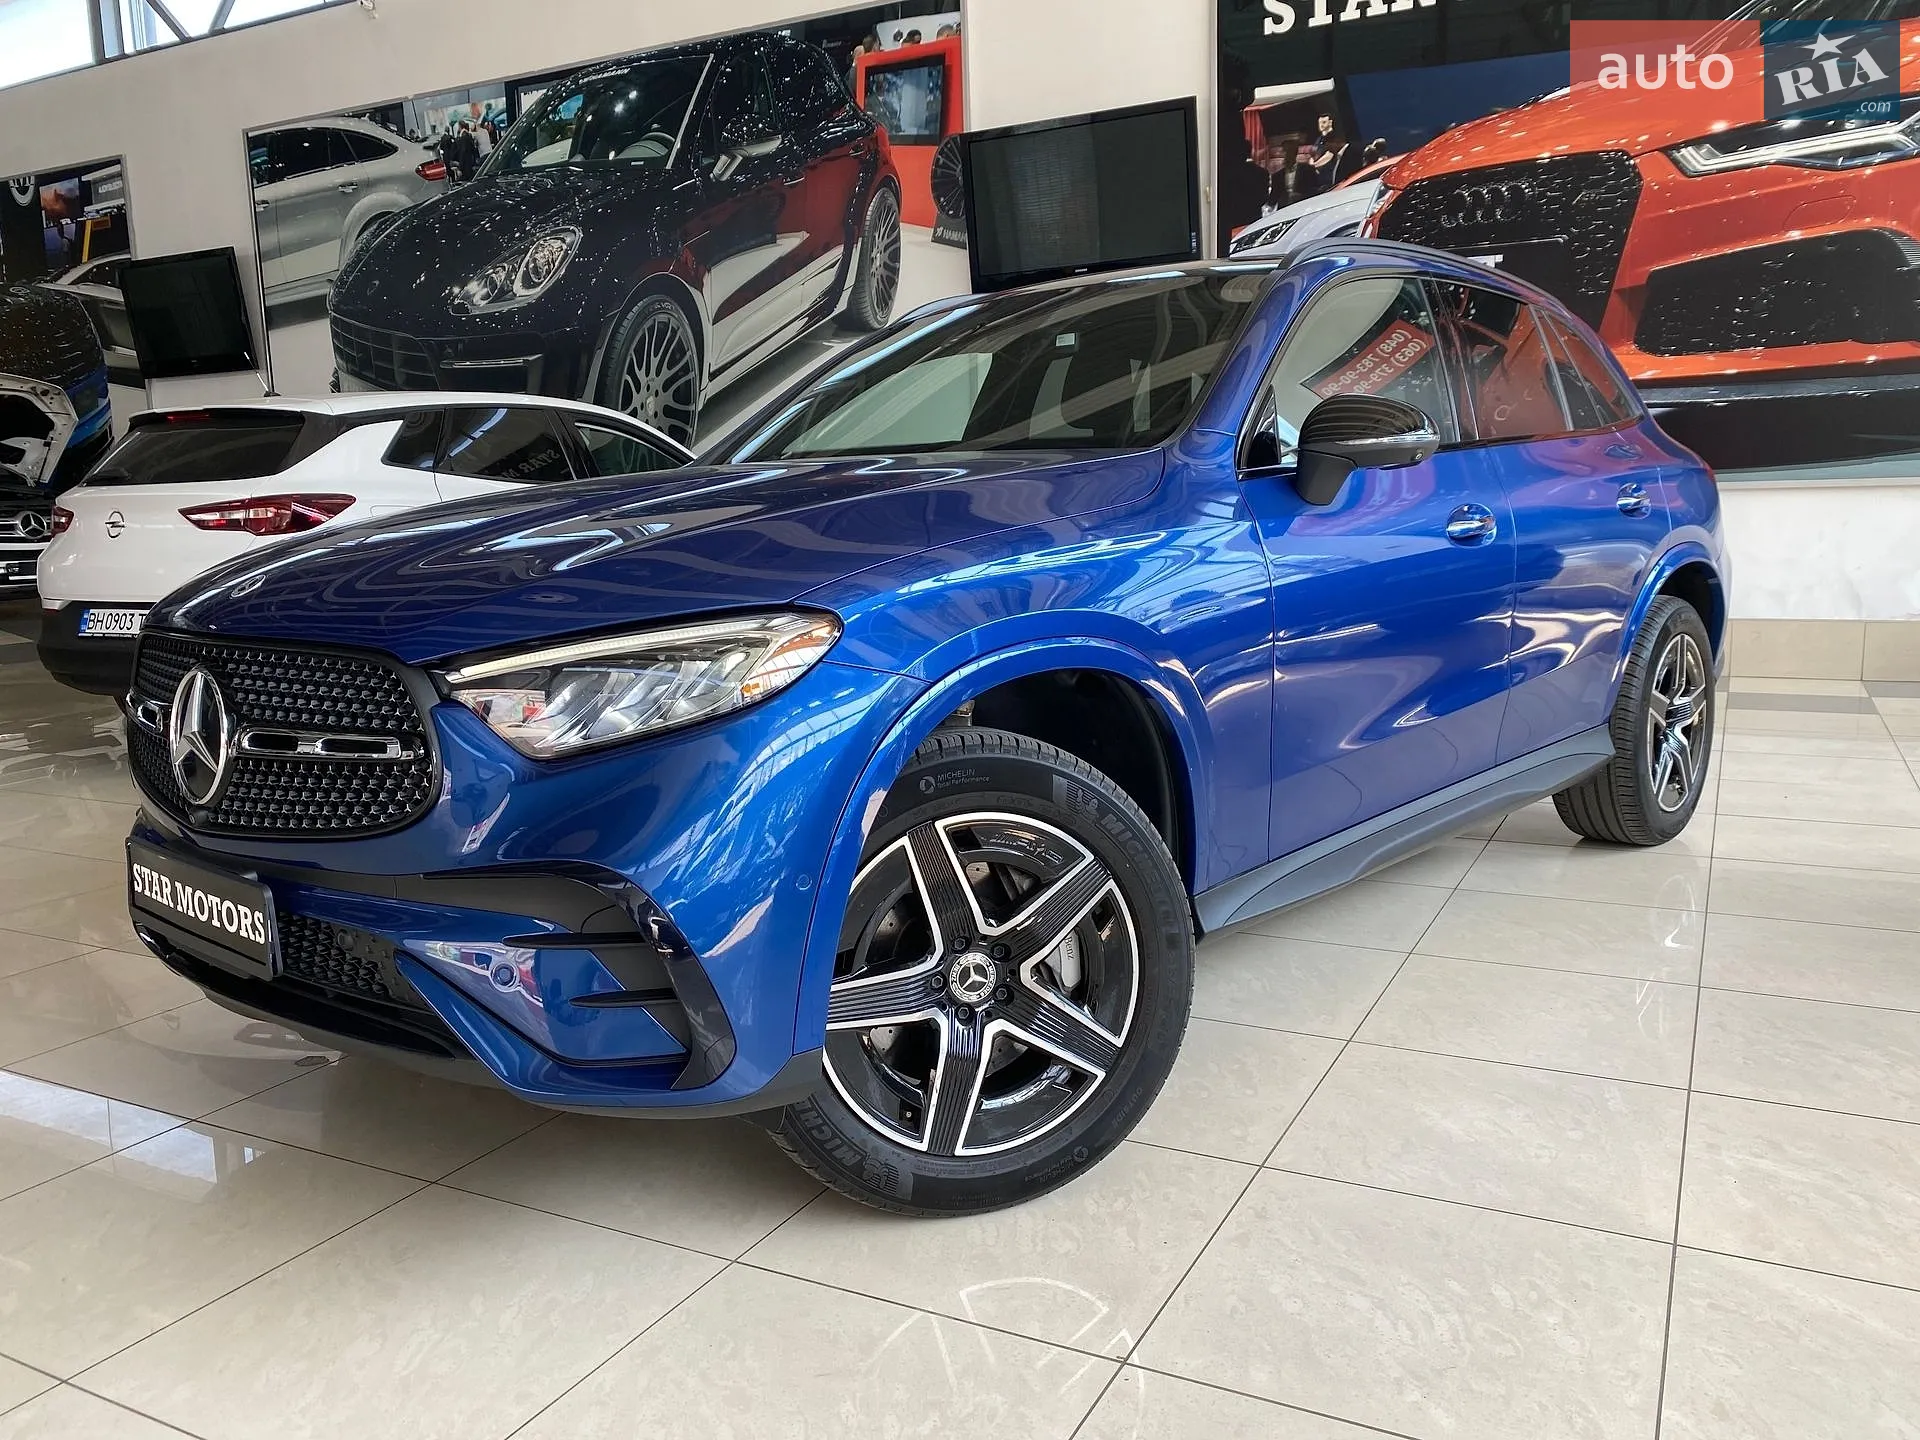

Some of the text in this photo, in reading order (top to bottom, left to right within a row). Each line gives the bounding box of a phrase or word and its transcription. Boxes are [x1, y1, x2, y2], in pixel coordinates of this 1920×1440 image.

[937, 768, 976, 782] MICHELIN
[132, 863, 266, 945] STAR MOTORS
